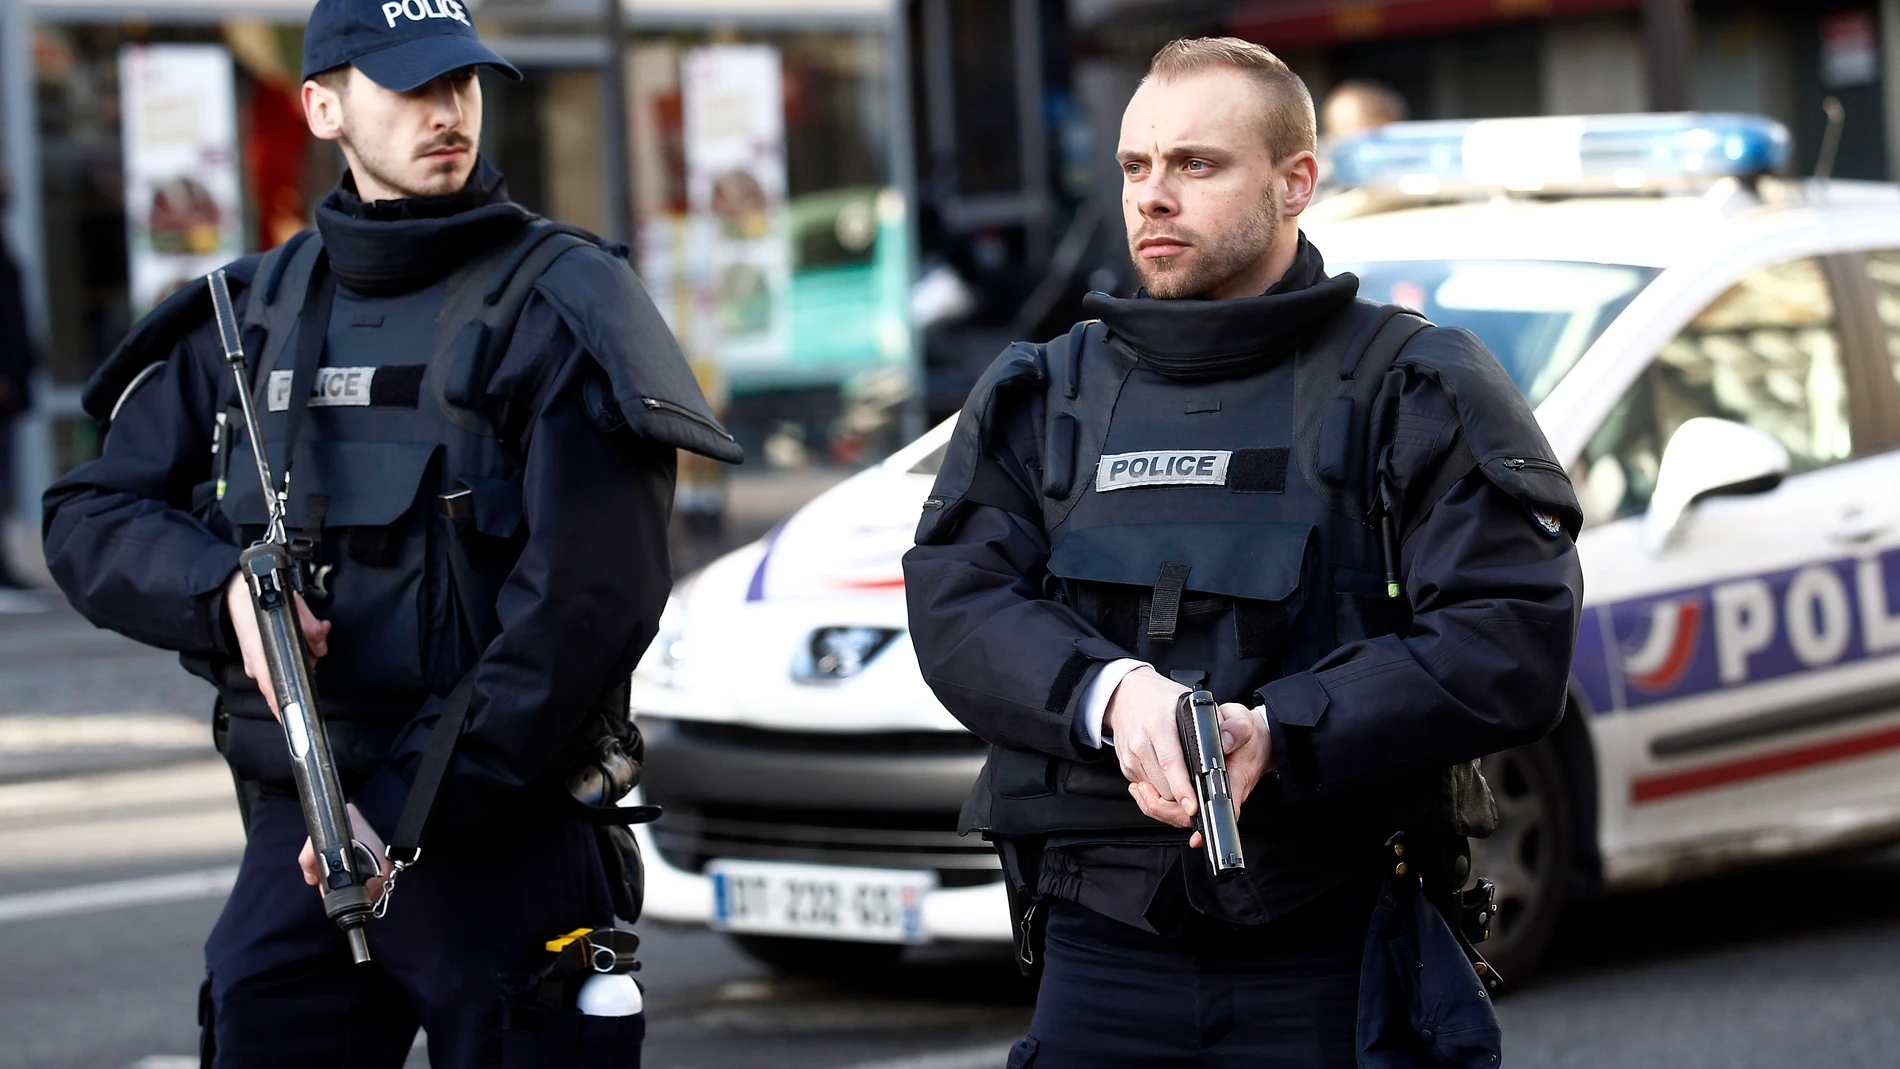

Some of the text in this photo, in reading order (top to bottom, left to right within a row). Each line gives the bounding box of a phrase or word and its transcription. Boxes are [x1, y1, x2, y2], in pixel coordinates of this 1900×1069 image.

[381, 0, 471, 28] POLICE
[277, 372, 361, 402] PICE
[1109, 455, 1216, 481] POLICE
